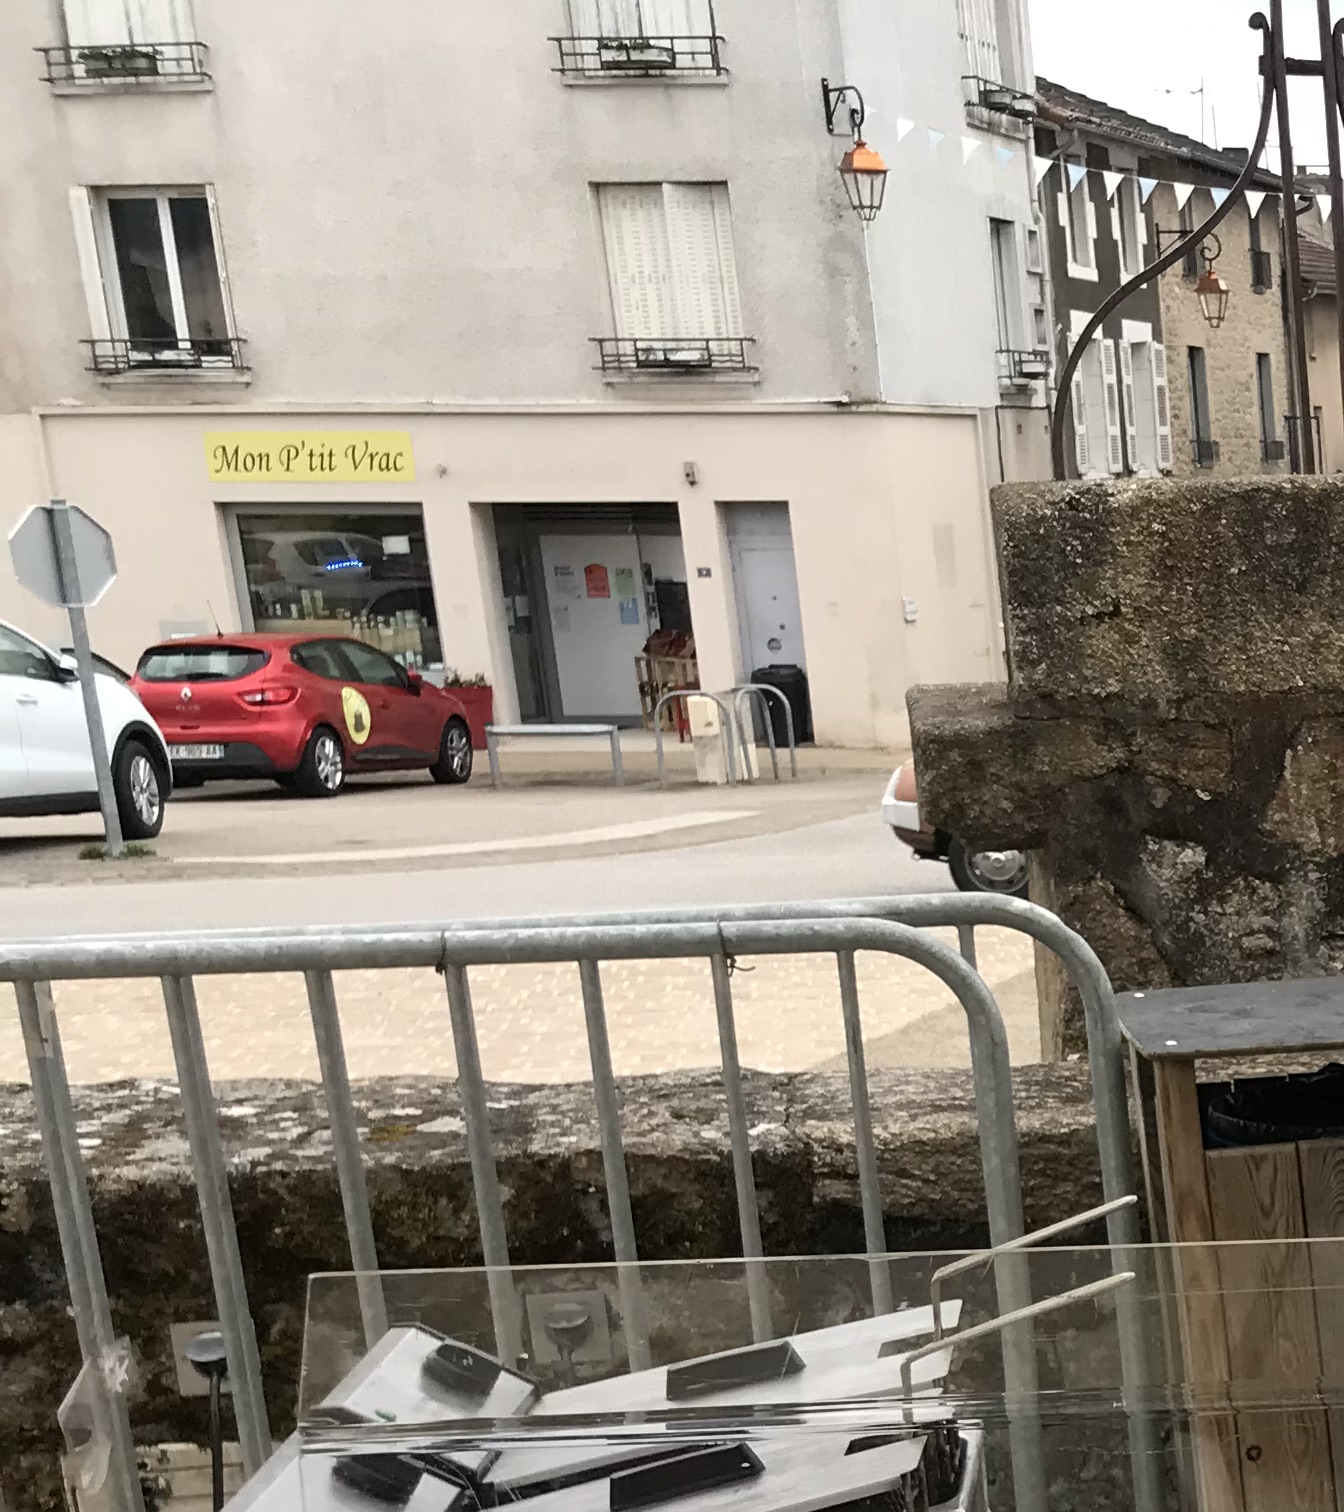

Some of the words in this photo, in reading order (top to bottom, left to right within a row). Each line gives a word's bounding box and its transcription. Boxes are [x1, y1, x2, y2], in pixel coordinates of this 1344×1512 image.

[213, 444, 273, 474] Mon
[278, 440, 337, 473] P'tit
[344, 440, 405, 473] Vrac
